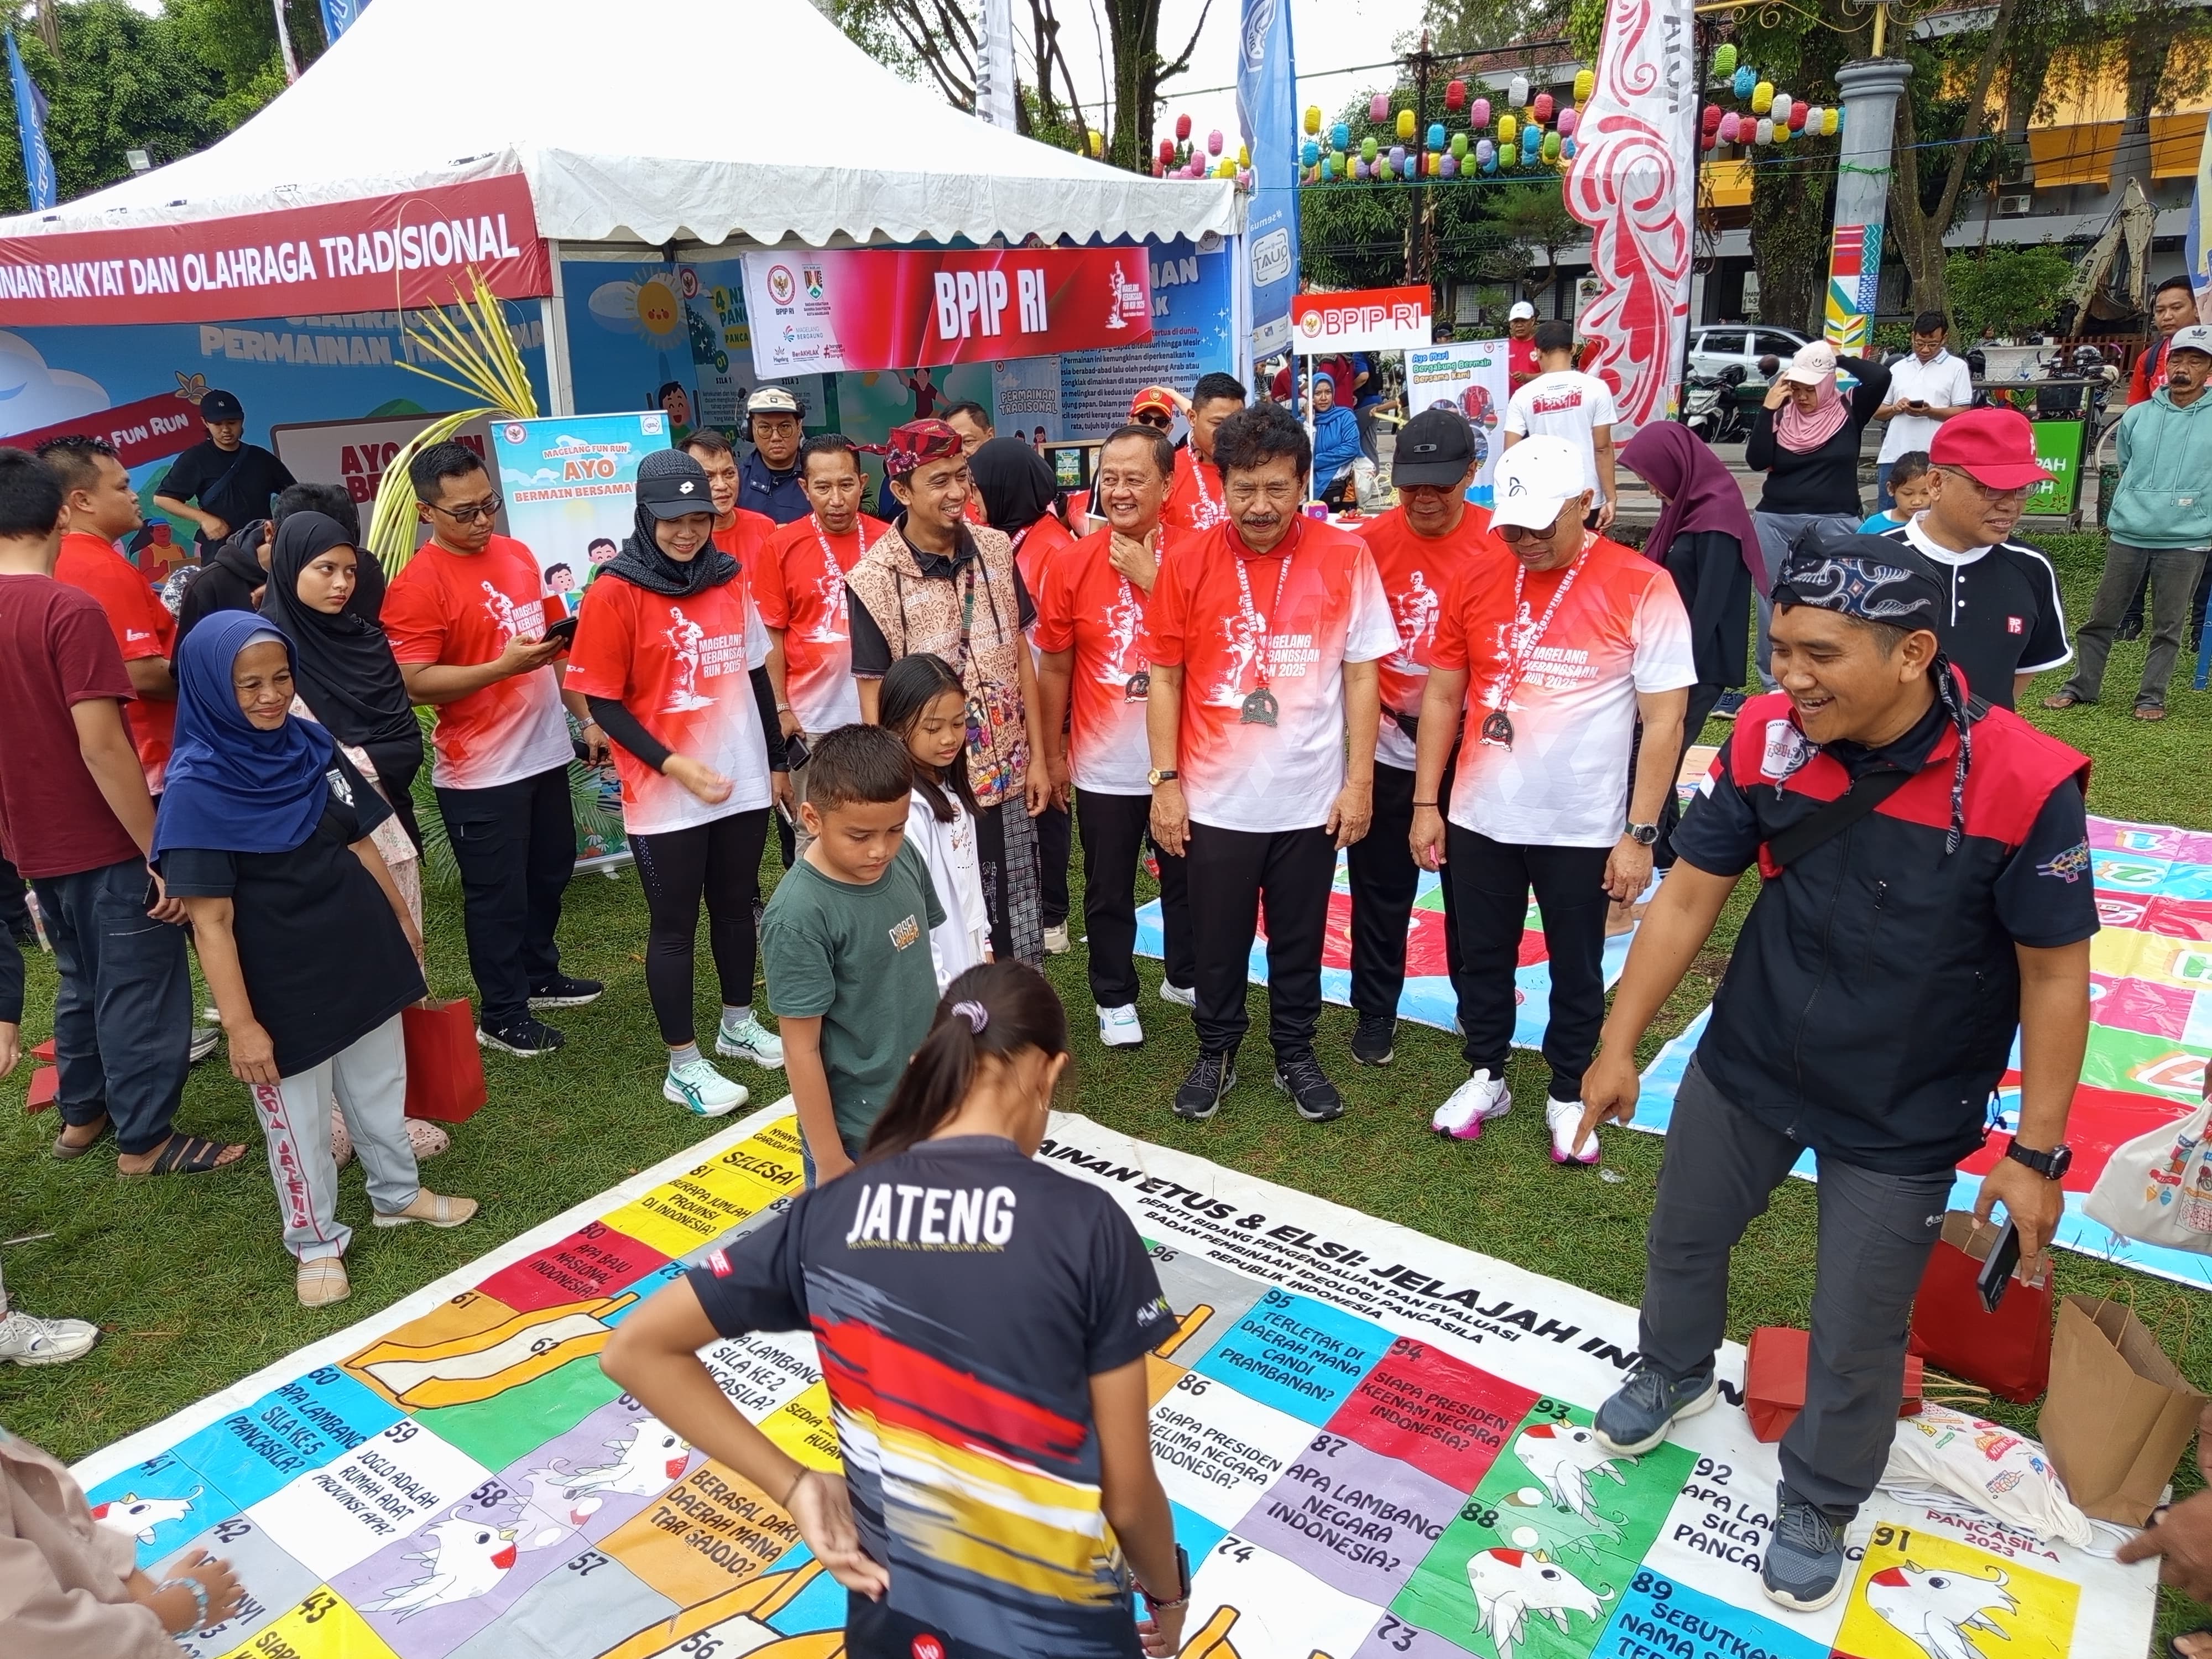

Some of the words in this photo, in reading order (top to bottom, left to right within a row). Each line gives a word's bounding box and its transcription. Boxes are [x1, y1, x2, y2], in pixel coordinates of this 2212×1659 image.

[46, 260, 124, 298] RAKYAT
[129, 257, 180, 295] DAN
[184, 242, 316, 293] OLAHRAGA
[320, 215, 519, 279] TRADISIONAL
[1123, 284, 1139, 292] MAGELANG
[935, 269, 1008, 339] BPIP
[1018, 269, 1048, 333] RI
[1324, 306, 1385, 335] BPIP
[1393, 303, 1422, 330] RI
[200, 325, 393, 367] PERMAINAN
[792, 349, 820, 357] BerAKHLAK
[1161, 339, 1182, 349] hingga
[1183, 338, 1201, 347] Mesir
[1072, 366, 1112, 375] berabad-abad
[1125, 364, 1138, 373] oleh
[1139, 364, 1168, 374] pedagang
[1170, 363, 1185, 371] Arab
[1103, 353, 1142, 363] kemungkinan
[1143, 352, 1186, 362] diperkenalkan
[1412, 353, 1428, 363] Ayo
[1413, 361, 1456, 373] Bergabung
[1459, 358, 1491, 368] Bermain
[1061, 379, 1087, 388] Congklak
[1088, 378, 1117, 386] dimainkan
[1139, 377, 1157, 385] papan
[1158, 375, 1173, 385] yang
[1413, 372, 1448, 384] Bersama
[1451, 370, 1470, 380] Kami
[1000, 388, 1056, 403] PERMAINAN
[1068, 389, 1096, 398] melingkar
[1099, 399, 1118, 408] Dalam
[999, 401, 1058, 415] TRADISONAL
[1092, 410, 1110, 420] kerang
[149, 413, 189, 436] RUN
[544, 445, 591, 459] MAGELANG
[565, 460, 614, 481] AYO
[515, 488, 573, 503] BERMAIN
[575, 484, 633, 497] BERSAMA
[905, 592, 929, 608] FADLU
[703, 664, 721, 679] RUN
[1279, 664, 1306, 677] 2025
[1547, 676, 1578, 690] 2025
[689, 1166, 714, 1178] 81
[722, 1151, 802, 1186] SELESAI
[278, 1139, 309, 1229] JATENG
[668, 1179, 709, 1202] BERAPA
[708, 1192, 752, 1219] JUMLAH
[641, 1197, 658, 1208] DI
[656, 1204, 718, 1236] INDONESIA?
[846, 1184, 1016, 1244] JATENG
[578, 1223, 607, 1239] 80
[573, 1244, 599, 1259] APA
[597, 1253, 633, 1273] BAJU
[1135, 1177, 1237, 1220] ETUS
[1235, 1214, 1266, 1230] &
[1269, 1225, 1371, 1266] ELSI:
[1369, 1264, 1582, 1343] JELAJAH
[1149, 1245, 1179, 1262] 96
[528, 1259, 601, 1298] INDONESIA?
[552, 1252, 613, 1285] NASIONAL
[1137, 1198, 1194, 1220] DEPUTI
[1194, 1217, 1254, 1243] BIDANG
[1252, 1239, 1385, 1291] PENGENDALIAN
[1383, 1289, 1426, 1307] DAN
[1426, 1303, 1521, 1342] EVALUASI
[1144, 1212, 1201, 1236] BADAN
[1199, 1234, 1297, 1270] PEMBINAAN
[1295, 1268, 1378, 1303] IDEOLOGI
[1378, 1299, 1484, 1344] PANCASILA
[1206, 1250, 1290, 1282] REPUBLIK
[1286, 1280, 1383, 1319] INDONESIA
[450, 1292, 480, 1310] 61
[1262, 1290, 1296, 1308] 95
[1240, 1320, 1309, 1355] DAERAH
[1308, 1350, 1361, 1376] MANA
[1263, 1312, 1344, 1353] TERLETAK
[1344, 1347, 1366, 1360] DI
[746, 1340, 825, 1385] LAMBANG
[1262, 1349, 1317, 1376] CANDI
[1391, 1339, 1425, 1362] 94
[307, 1367, 340, 1385] 60
[713, 1347, 751, 1374] SILA
[747, 1366, 786, 1392] KE-2
[1218, 1348, 1334, 1402] PRAMBANAN?
[1177, 1374, 1212, 1397] 86
[785, 1403, 823, 1428] SEDIA
[1360, 1382, 1431, 1419] KEENAM
[1435, 1412, 1502, 1448] NEGARA
[1373, 1372, 1425, 1400] SIAPA
[1428, 1393, 1509, 1432] PRESIDEN
[1534, 1399, 1571, 1420] 93
[260, 1405, 298, 1436] SILA
[286, 1426, 326, 1455] KE-5
[274, 1383, 310, 1405] APA
[298, 1401, 367, 1450] LAMBANG
[1370, 1406, 1470, 1452] INDONESIA?
[224, 1415, 306, 1475] PANCASILA?
[384, 1421, 419, 1443] 59
[1155, 1407, 1201, 1434] SIAPA
[1204, 1428, 1283, 1472] PRESIDEN
[1310, 1435, 1348, 1458] 87
[140, 1454, 176, 1477] 41
[1203, 1446, 1268, 1486] NEGARA
[1694, 1458, 1733, 1485] 92
[338, 1465, 385, 1499] RUMAH
[375, 1494, 415, 1522] ADAT
[357, 1450, 393, 1477] JOGLO
[388, 1468, 440, 1510] ADALAH
[471, 1481, 508, 1508] 58
[690, 1469, 764, 1523] BERASAL
[1286, 1464, 1331, 1493] APA
[1333, 1484, 1444, 1541] LAMBANG
[1681, 1484, 1731, 1513] APA
[666, 1486, 736, 1537] DAERAH
[728, 1526, 782, 1562] MANA
[1301, 1494, 1394, 1543] NEGARA
[1461, 1503, 1500, 1528] 88
[211, 1519, 251, 1544] 42
[650, 1506, 691, 1537] TARI
[685, 1529, 757, 1578] SAJOJO?
[1267, 1501, 1401, 1573] INDONESIA?
[1703, 1514, 1760, 1546] SILA
[1876, 1526, 1911, 1552] 91
[1926, 1510, 2060, 1563] PANCASILA
[1217, 1536, 1255, 1563] 74
[1964, 1533, 2015, 1557] 2023
[567, 1552, 609, 1577] 57
[1631, 1572, 1673, 1600] 89
[300, 1593, 337, 1624] 43
[681, 1632, 724, 1658] 56
[1377, 1615, 1419, 1652] 73
